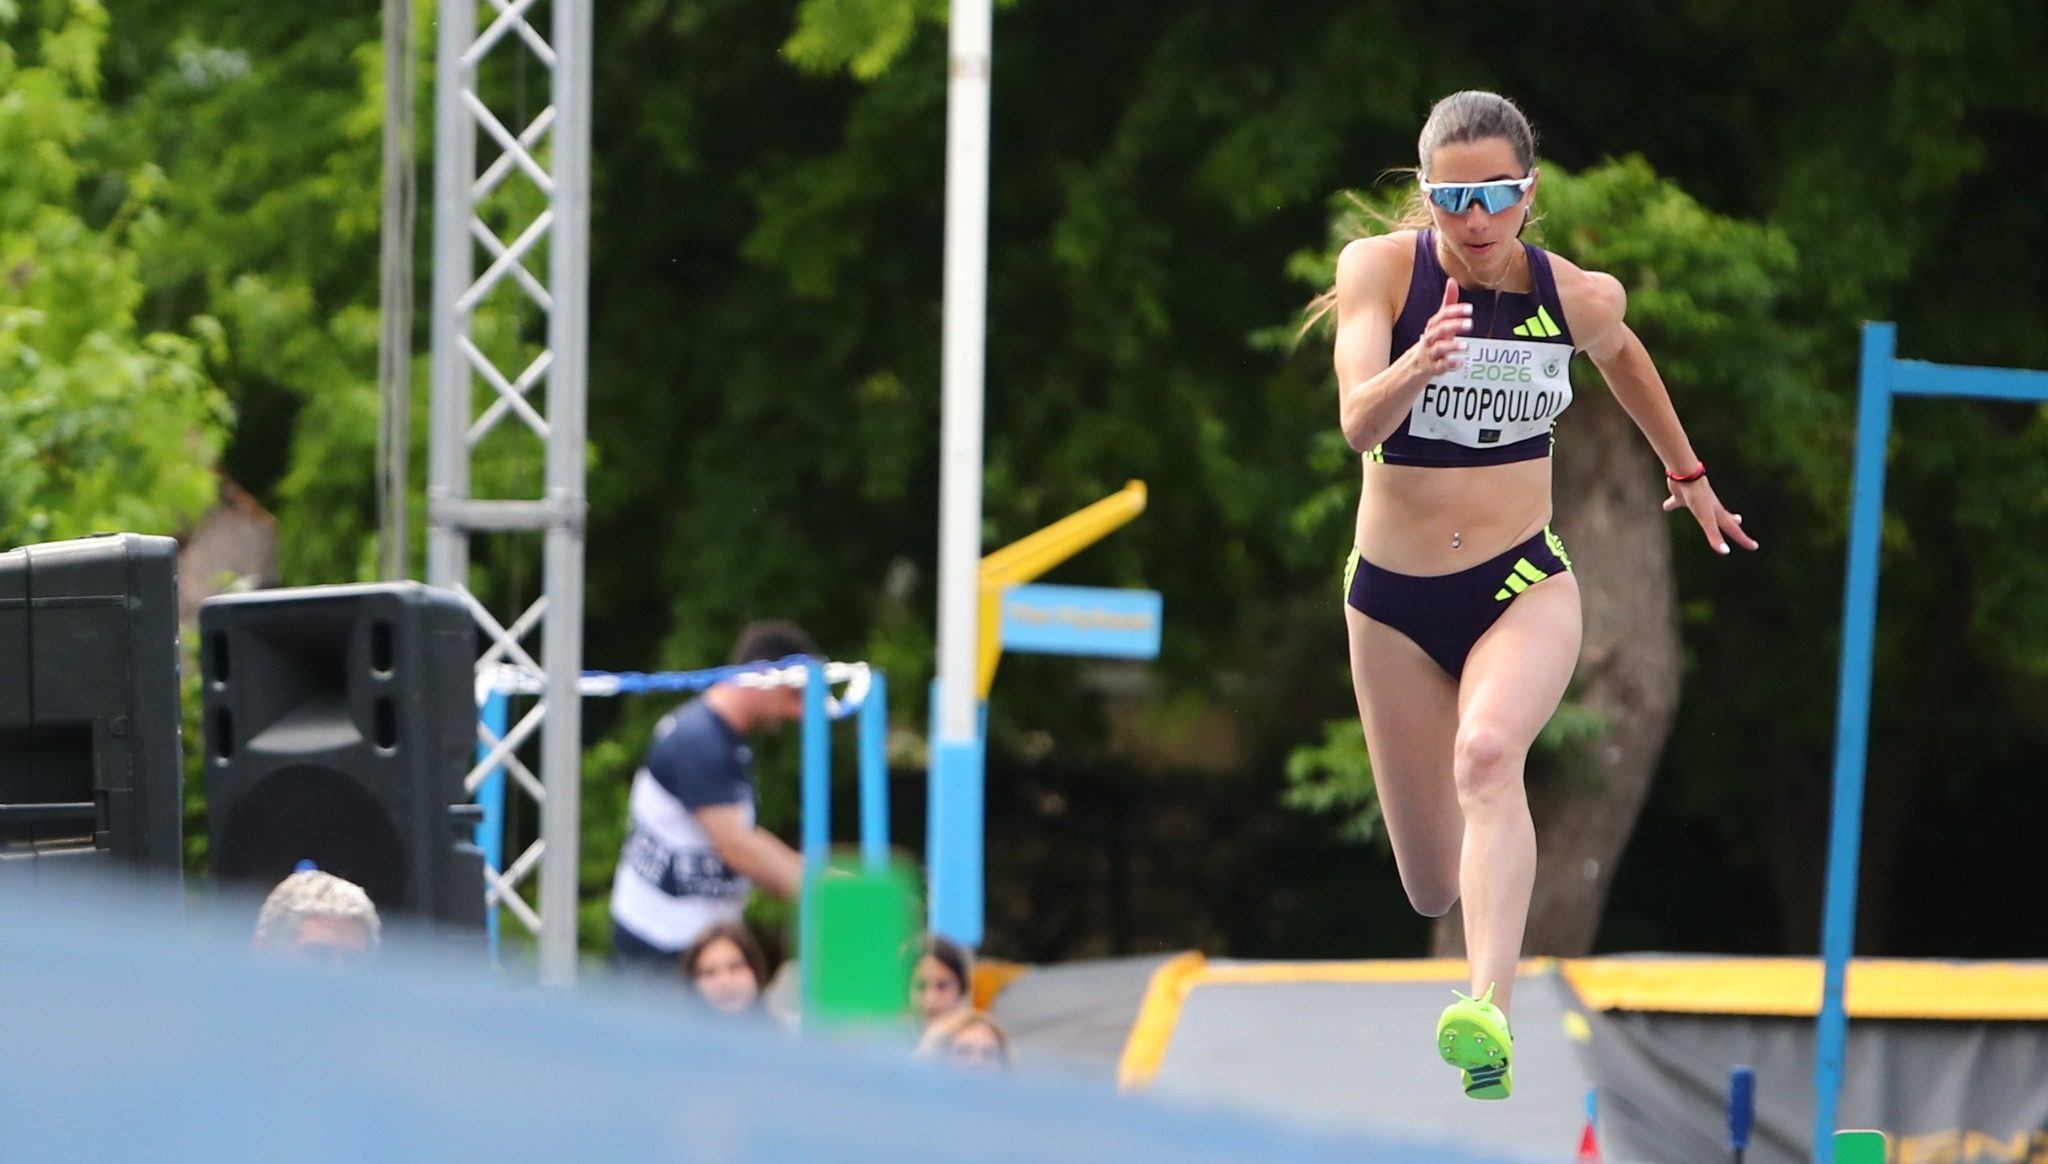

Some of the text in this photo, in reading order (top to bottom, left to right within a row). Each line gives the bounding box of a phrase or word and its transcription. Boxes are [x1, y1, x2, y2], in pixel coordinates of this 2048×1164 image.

[1472, 347, 1532, 365] JUMP
[1470, 364, 1532, 382] 2026
[1422, 384, 1562, 421] FOTOPOULOU
